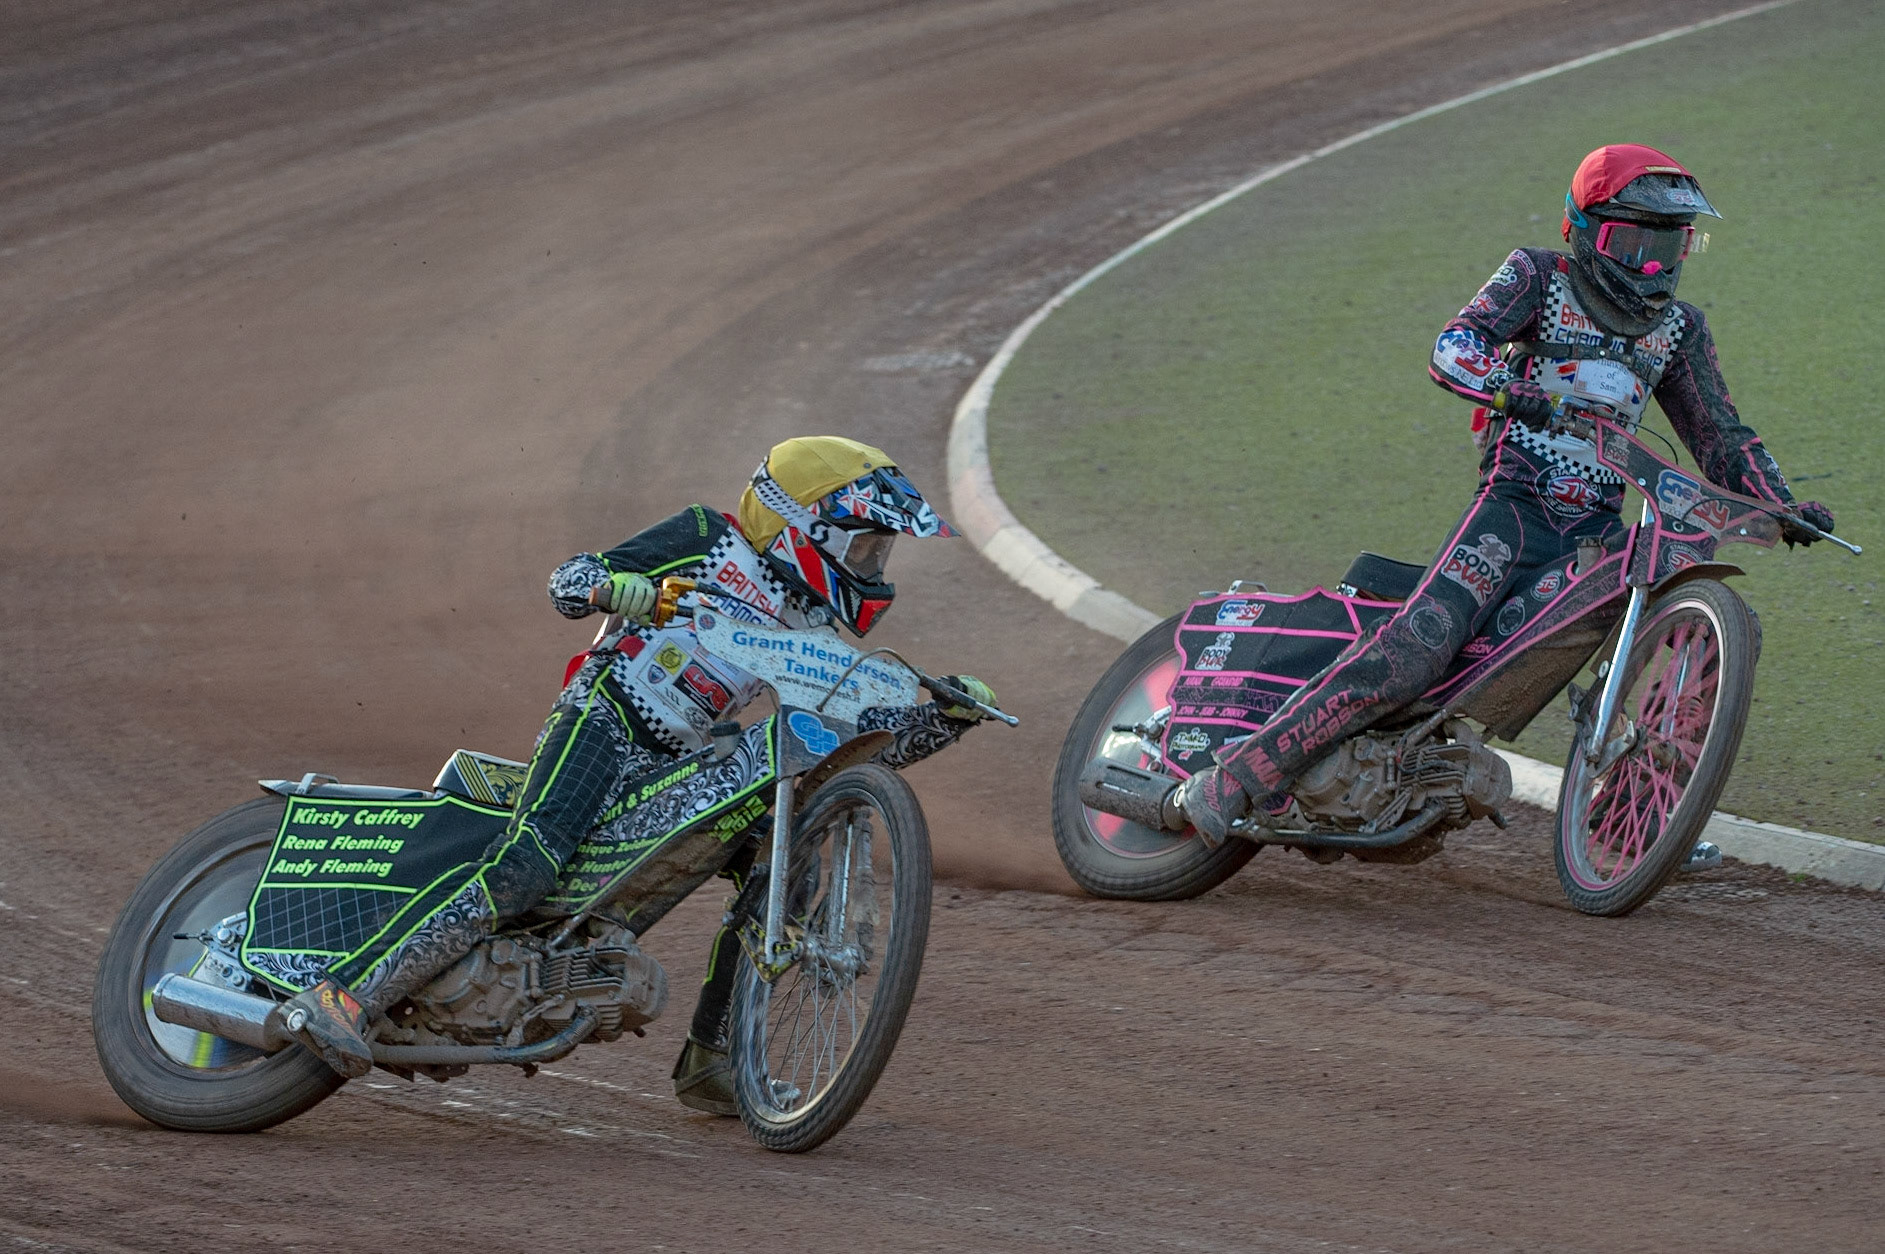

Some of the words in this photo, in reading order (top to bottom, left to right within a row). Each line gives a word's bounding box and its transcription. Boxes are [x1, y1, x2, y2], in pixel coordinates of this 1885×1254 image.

[1561, 304, 1602, 333] BRIT
[1606, 372, 1616, 380] of
[1444, 557, 1492, 602] PWR
[1453, 547, 1500, 583] BODY
[1536, 578, 1557, 589] STS
[732, 631, 795, 651] Grant
[802, 641, 900, 689] Henderson
[784, 658, 859, 691] Tankers
[1276, 689, 1353, 753] STUART
[1301, 690, 1380, 755] ROBSON
[627, 792, 639, 808] &
[640, 761, 699, 801] Suzanne
[292, 807, 350, 828] Kirsty
[353, 808, 424, 829] Caffrey
[281, 835, 327, 851] Rena
[330, 835, 405, 854] Fleming
[271, 858, 317, 877] Andy
[319, 859, 393, 878] Fleming
